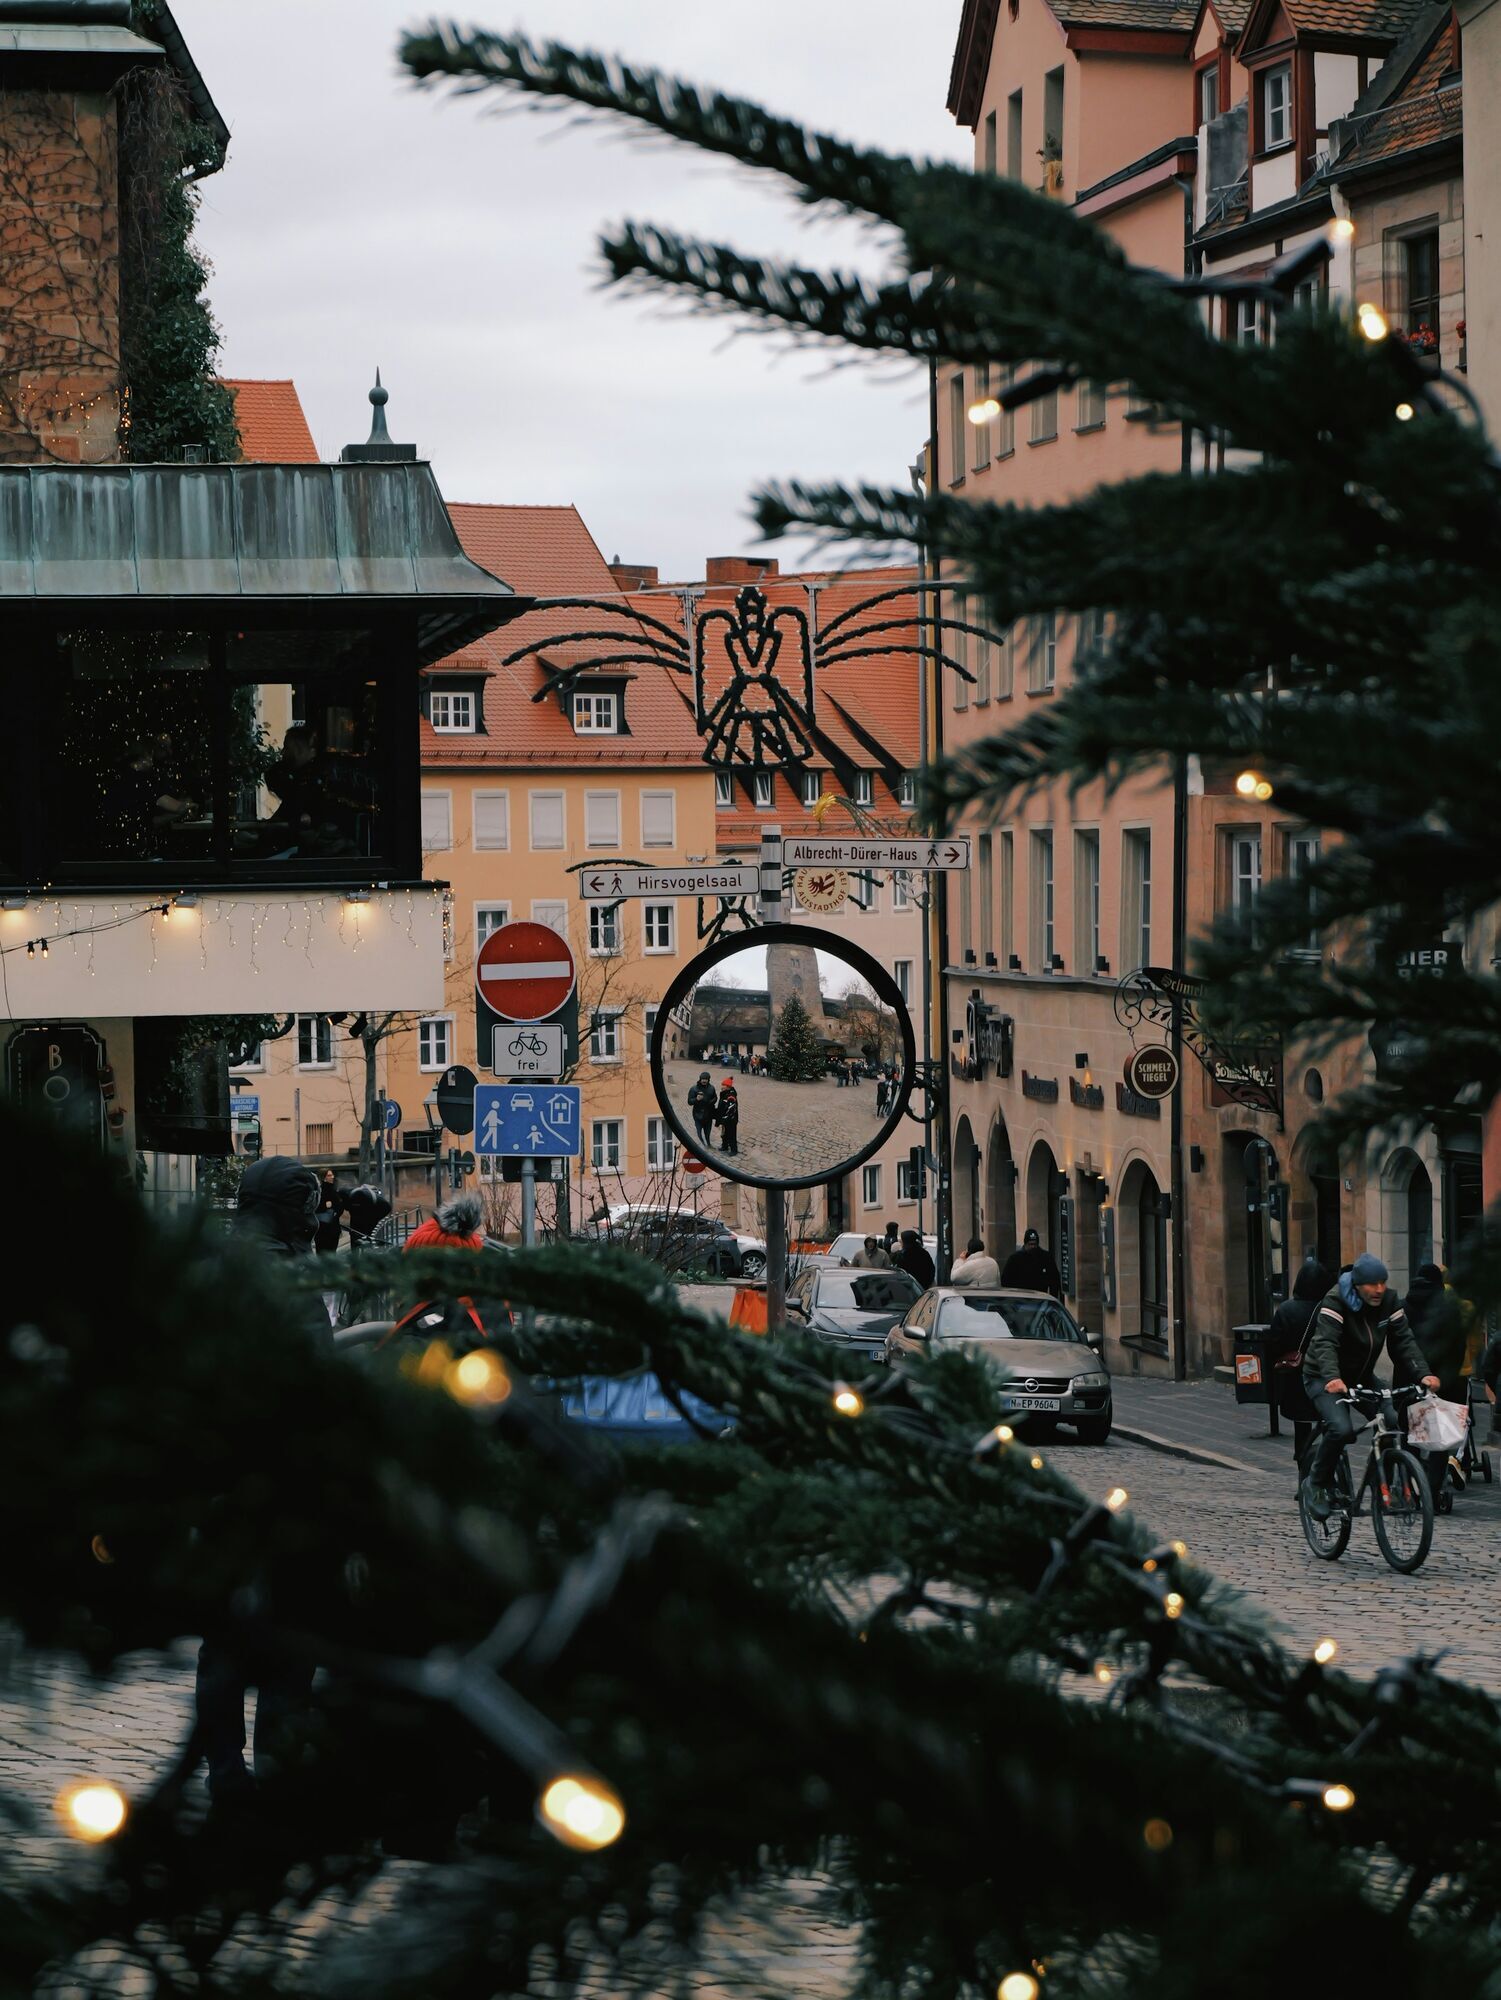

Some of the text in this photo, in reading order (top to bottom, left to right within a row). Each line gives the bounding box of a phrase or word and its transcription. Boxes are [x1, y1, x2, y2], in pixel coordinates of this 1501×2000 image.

[793, 844, 918, 863] Albrecht-Dürer-Haus
[637, 873, 742, 891] Hirsvogelsaal
[798, 889, 846, 911] ALTSTADTHOF
[517, 1058, 540, 1071] frei
[1138, 1062, 1172, 1073] SCHMELZ
[1142, 1072, 1168, 1082] TIEGEL
[1021, 1399, 1033, 1409] EP
[1034, 1399, 1054, 1410] 9604
